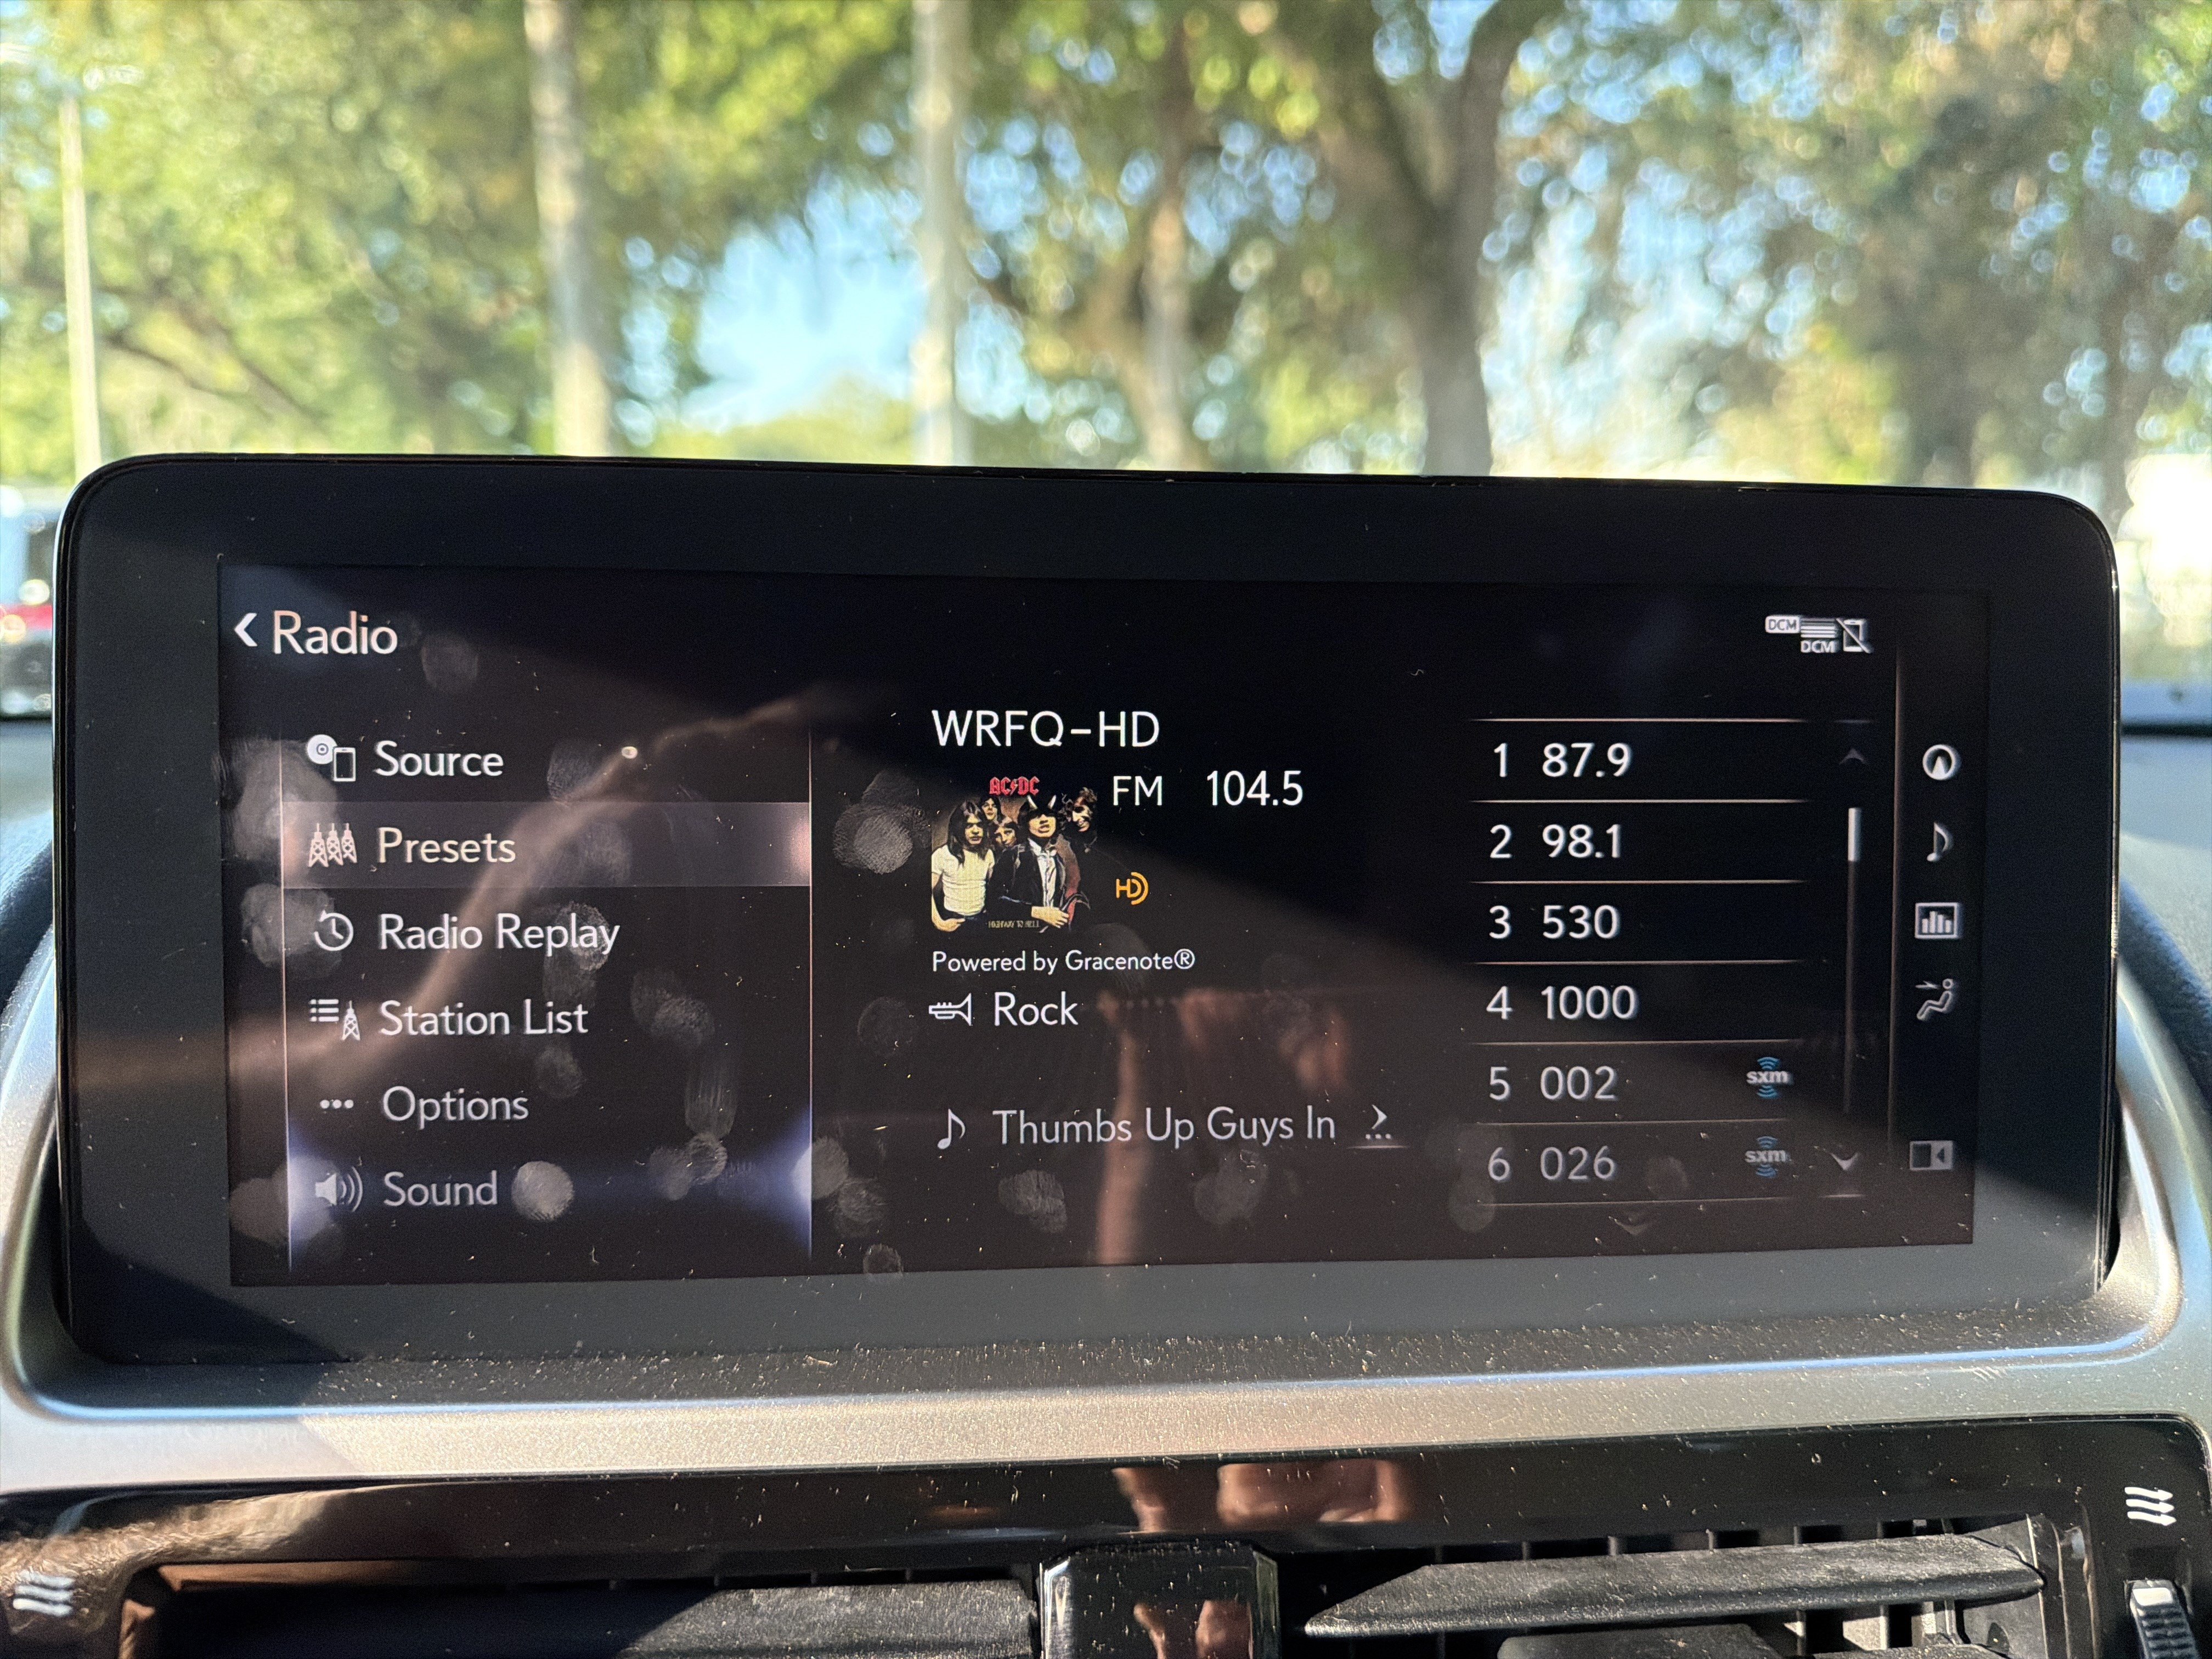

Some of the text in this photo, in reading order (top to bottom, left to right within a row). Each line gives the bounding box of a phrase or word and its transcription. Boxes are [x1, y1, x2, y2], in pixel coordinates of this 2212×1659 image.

[274, 610, 398, 655] Radio
[1767, 617, 1798, 631] DCM
[1801, 640, 1836, 653] DCM
[933, 710, 1160, 748] WRFQ-HD
[375, 740, 504, 778] Source
[1493, 743, 1632, 777] 1 87.9
[1113, 771, 1304, 806] FM 104.5
[377, 827, 516, 864] Presets
[1490, 823, 1622, 859] 2 98.1
[380, 913, 620, 956] Radio Replay
[1488, 905, 1620, 939] 3 530
[933, 951, 1026, 972] Powered
[1034, 951, 1058, 975] by
[380, 999, 589, 1036] Station List
[994, 992, 1079, 1026] Rock
[1487, 986, 1638, 1020] 4 1000
[1488, 1066, 1790, 1101] 5 002 sxm
[382, 1086, 529, 1128] Options
[992, 1105, 1335, 1148] Thumbs Up Guys In
[1488, 1146, 1788, 1181] 6 026 sxm
[383, 1170, 498, 1206] Sound
